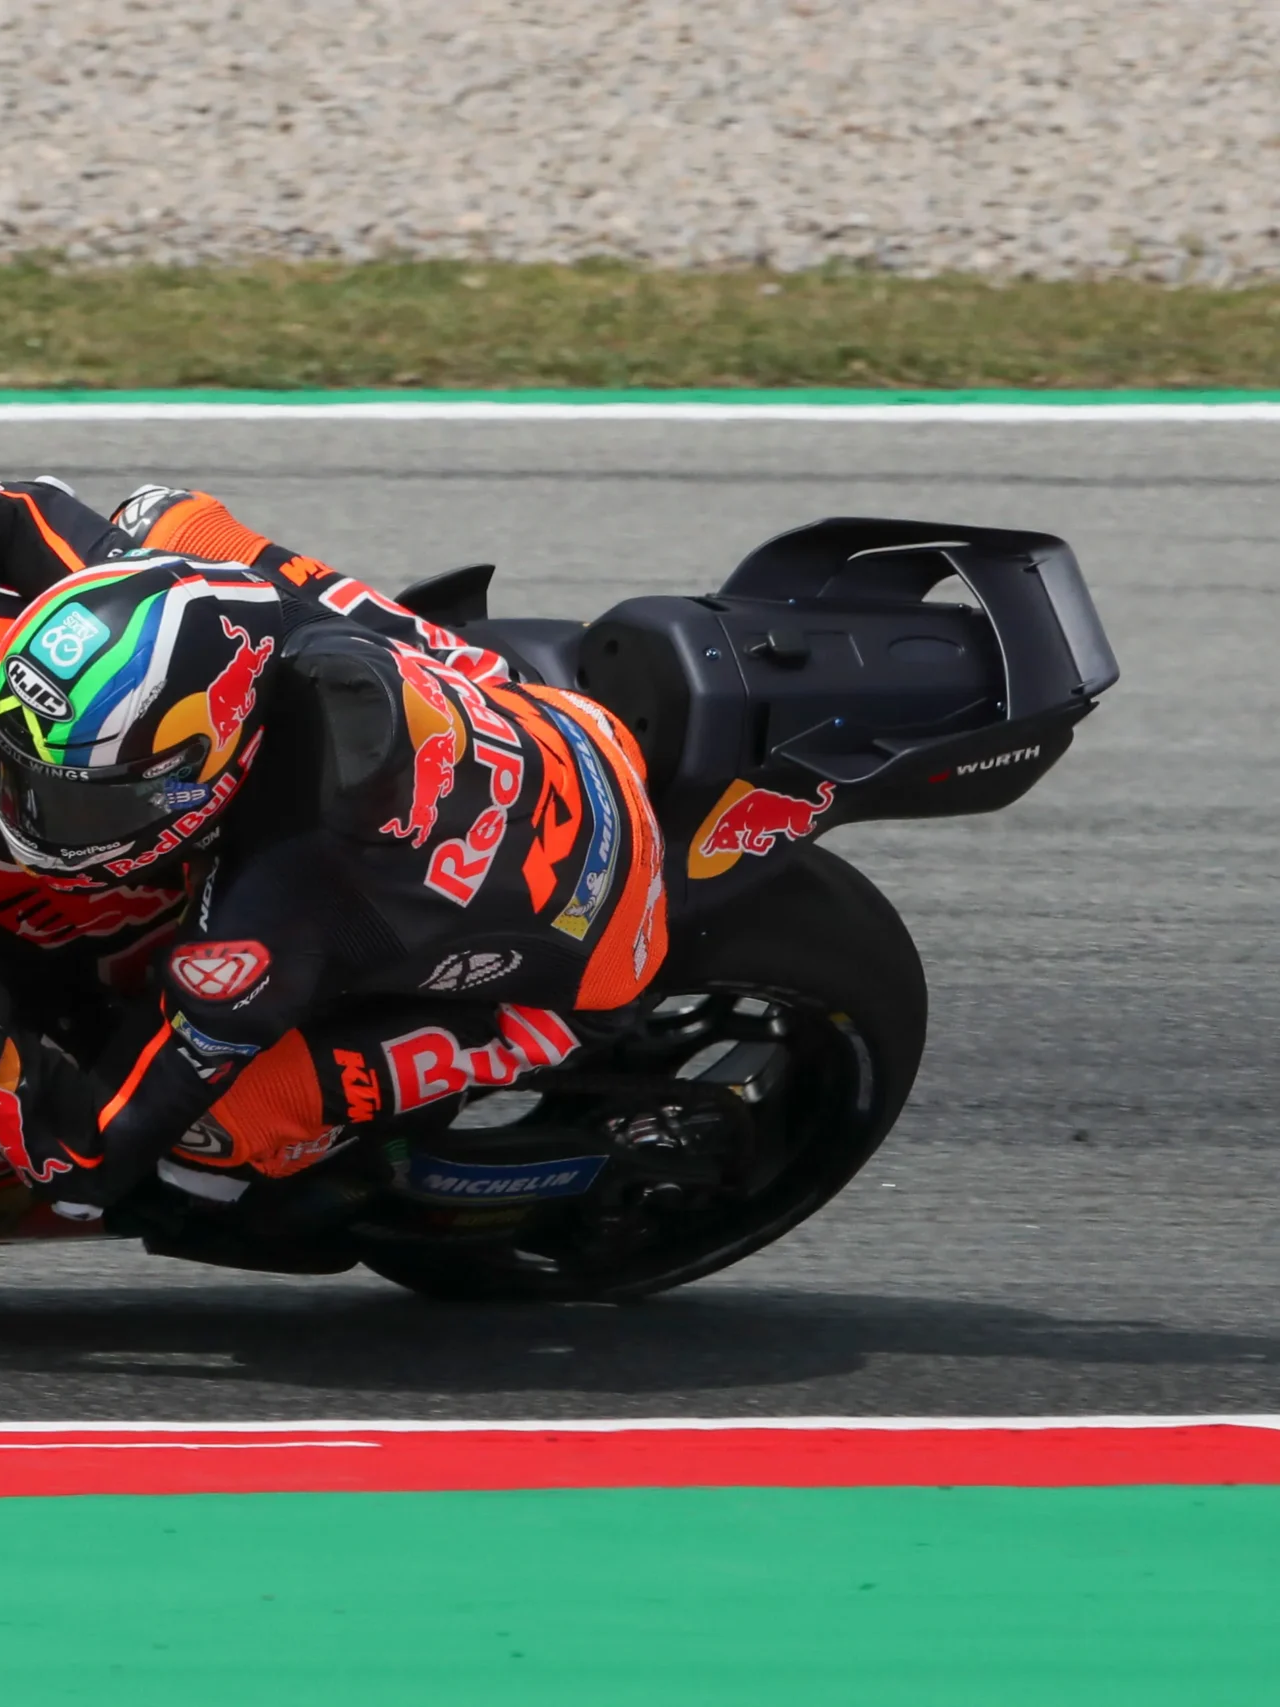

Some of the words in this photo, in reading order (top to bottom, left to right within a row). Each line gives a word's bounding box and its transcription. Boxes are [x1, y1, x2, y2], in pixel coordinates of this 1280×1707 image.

[7, 663, 66, 716] HJC
[29, 760, 90, 781] WINGS
[103, 828, 180, 877] Red
[173, 771, 238, 837] Bull
[423, 738, 524, 908] Red
[232, 974, 270, 1011] IXON
[333, 1047, 382, 1124] KTM
[381, 1002, 582, 1115] Bull
[423, 1169, 581, 1195] MICHELIN
